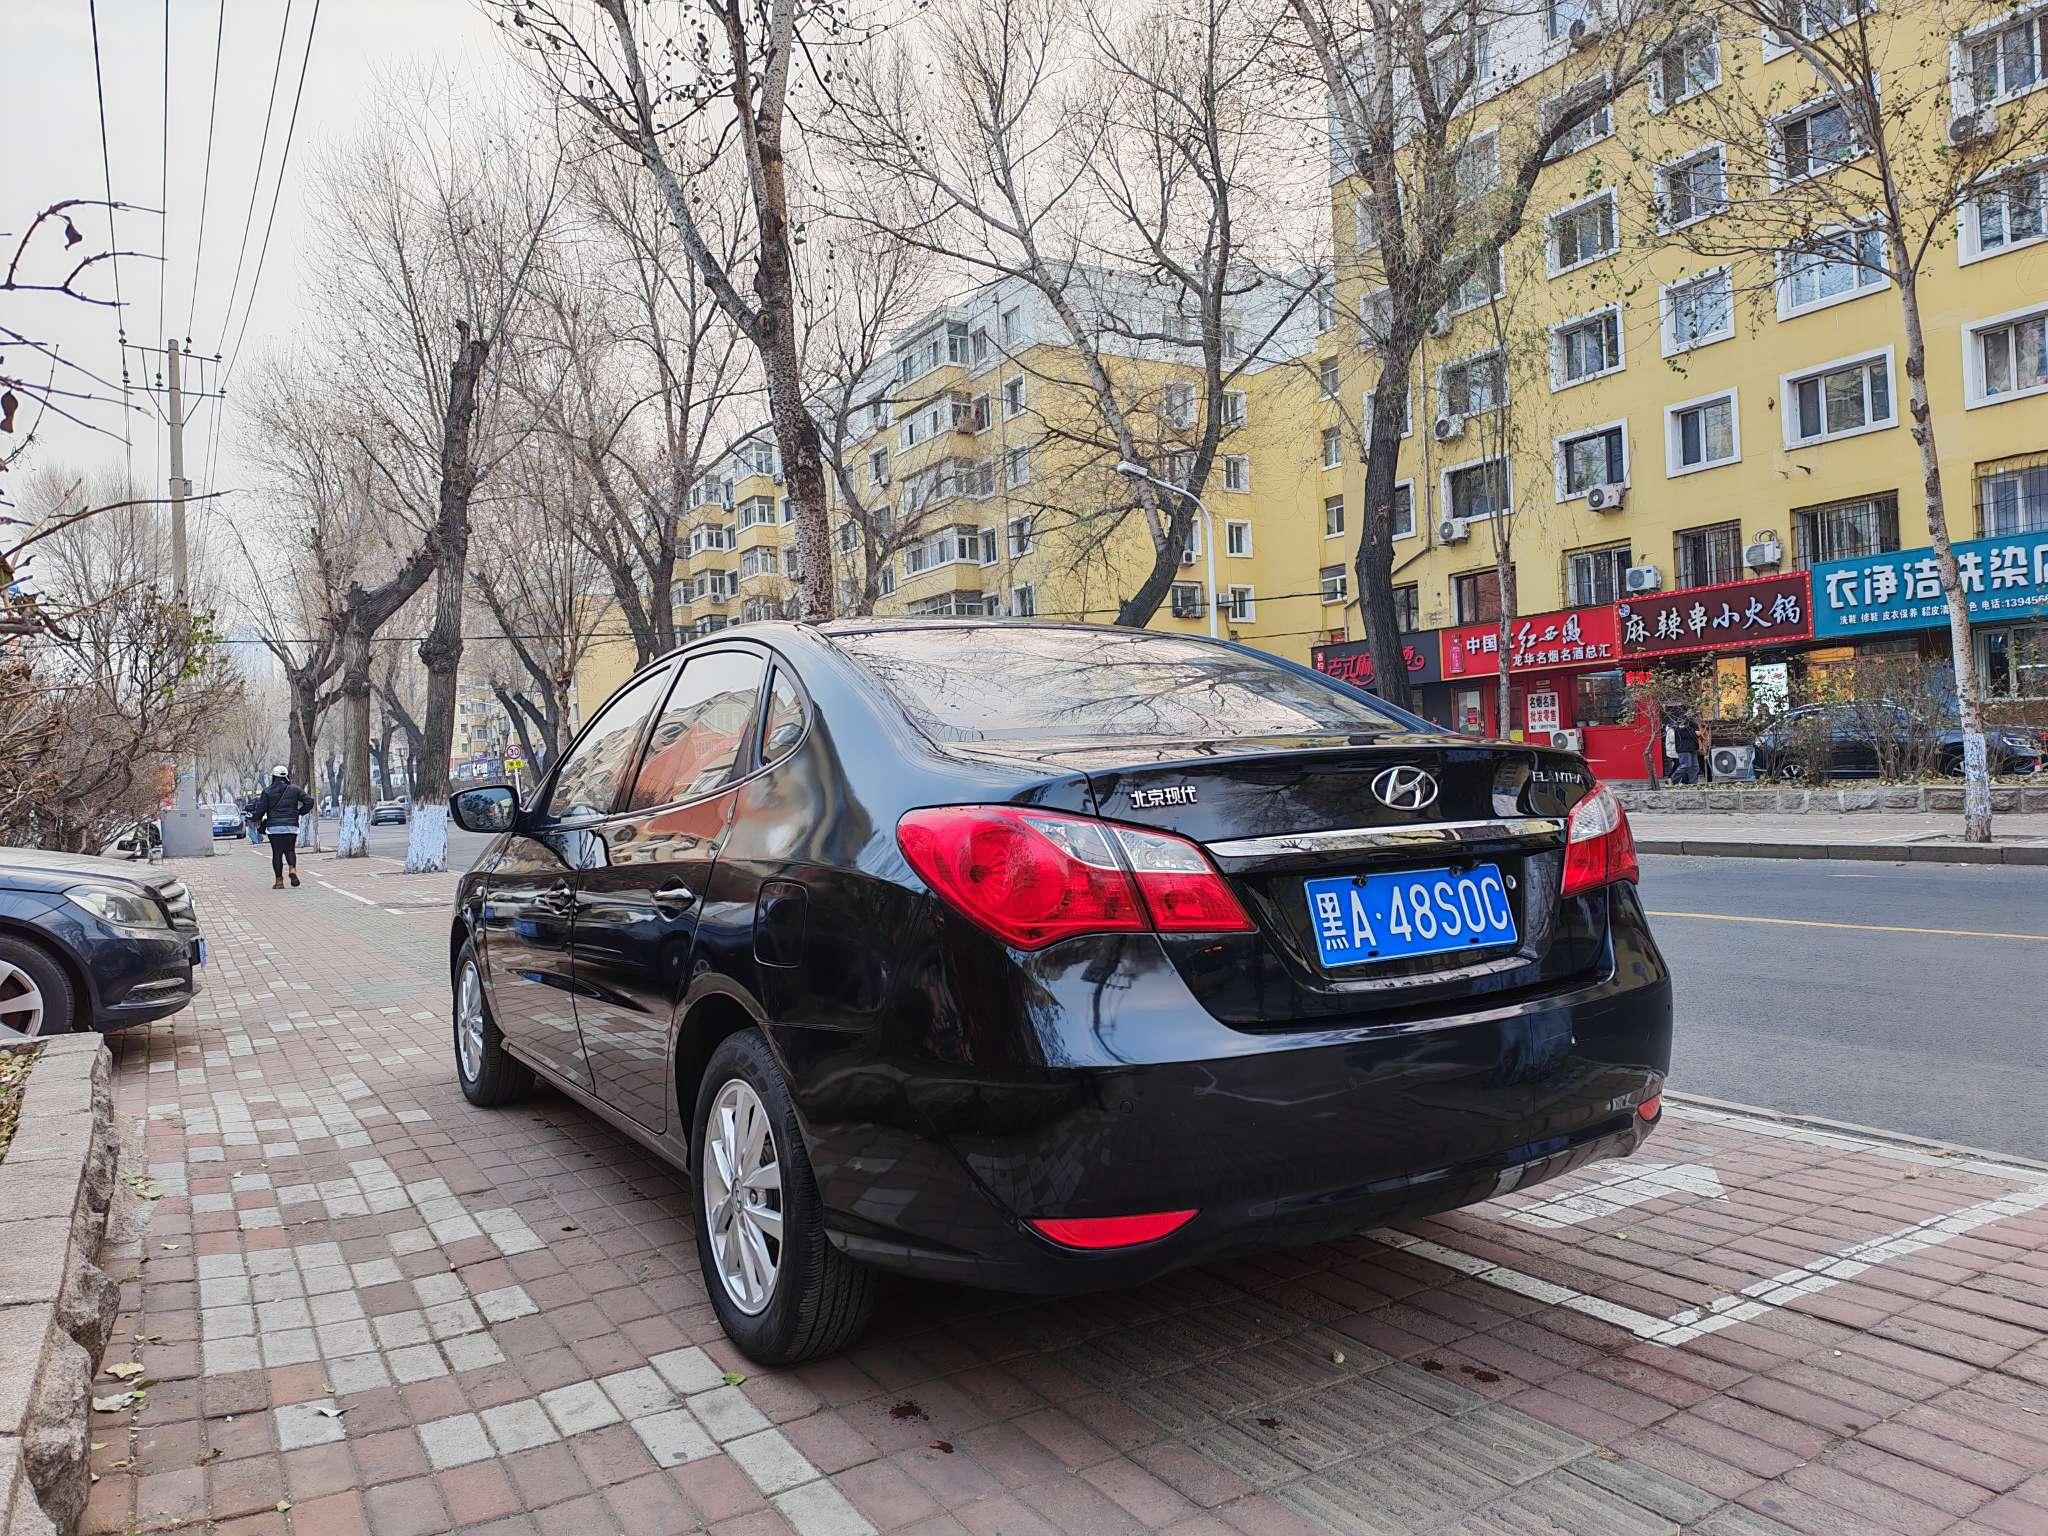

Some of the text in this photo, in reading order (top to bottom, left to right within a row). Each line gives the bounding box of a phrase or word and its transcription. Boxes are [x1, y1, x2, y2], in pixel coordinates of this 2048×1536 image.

[1623, 593, 1801, 645] 麻辣串小火锅
[1883, 607, 1918, 621] 皮衣保养
[1513, 643, 1611, 667] 龙华名烟名酒总汇
[509, 747, 519, 756] 30
[1130, 785, 1198, 808] 北京现代
